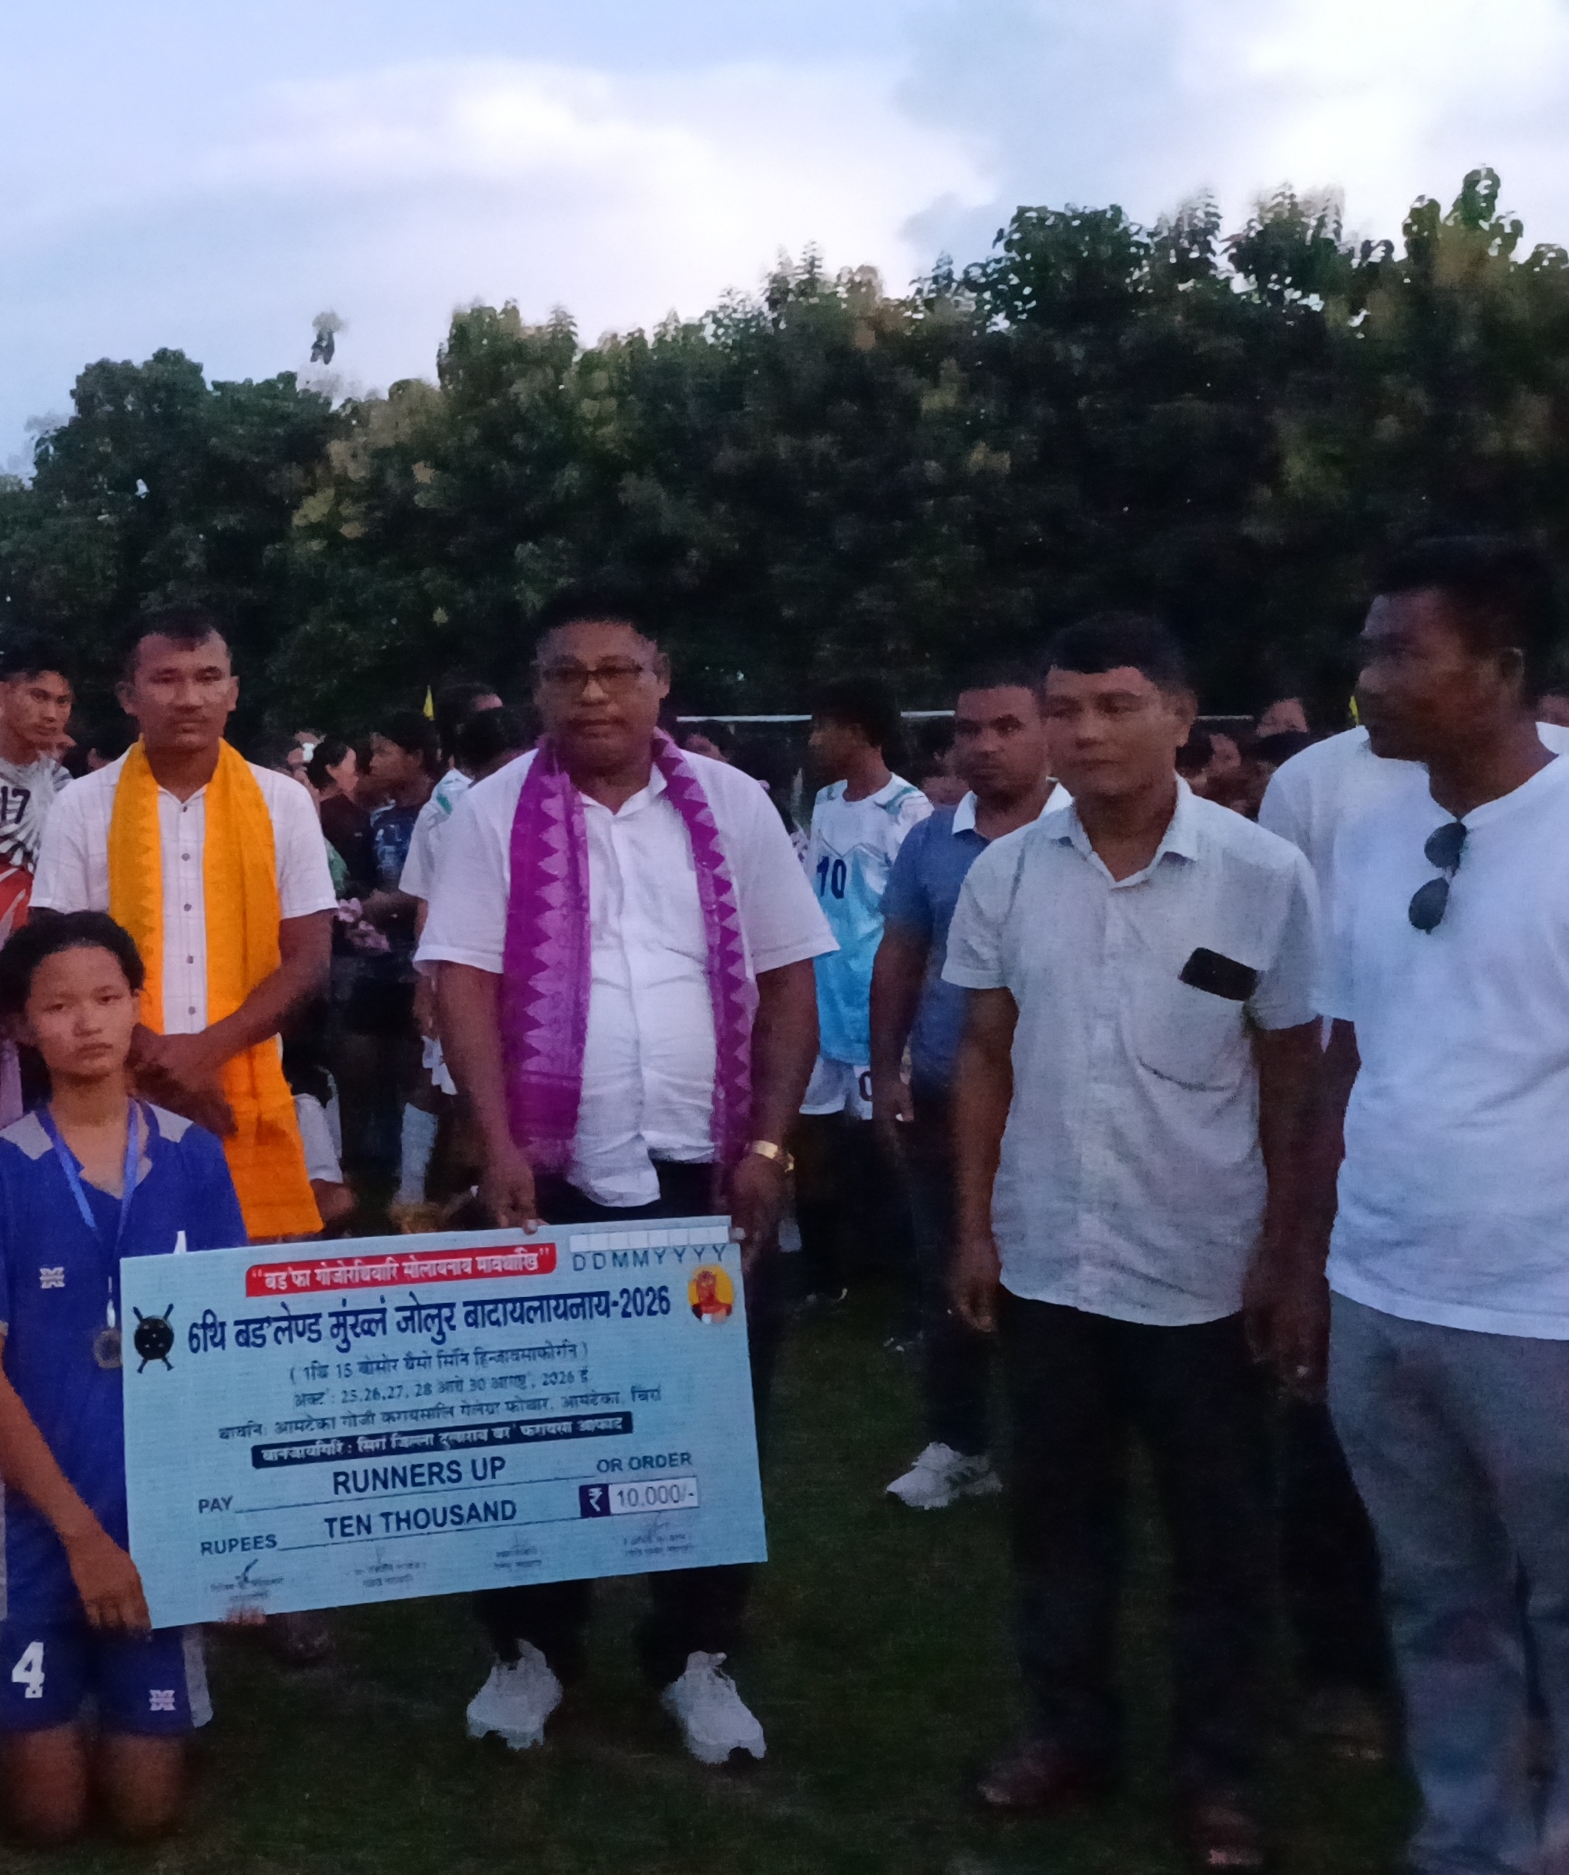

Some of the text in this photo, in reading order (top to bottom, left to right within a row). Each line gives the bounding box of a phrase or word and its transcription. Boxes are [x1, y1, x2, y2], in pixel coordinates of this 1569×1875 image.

[0, 786, 31, 824] 17
[817, 856, 847, 899] 10
[198, 1452, 692, 1513] PAY RUNNERS UP OR ORDER
[200, 1500, 517, 1557] RUPEES TEN THOUSAND
[12, 1641, 45, 1698] 4
